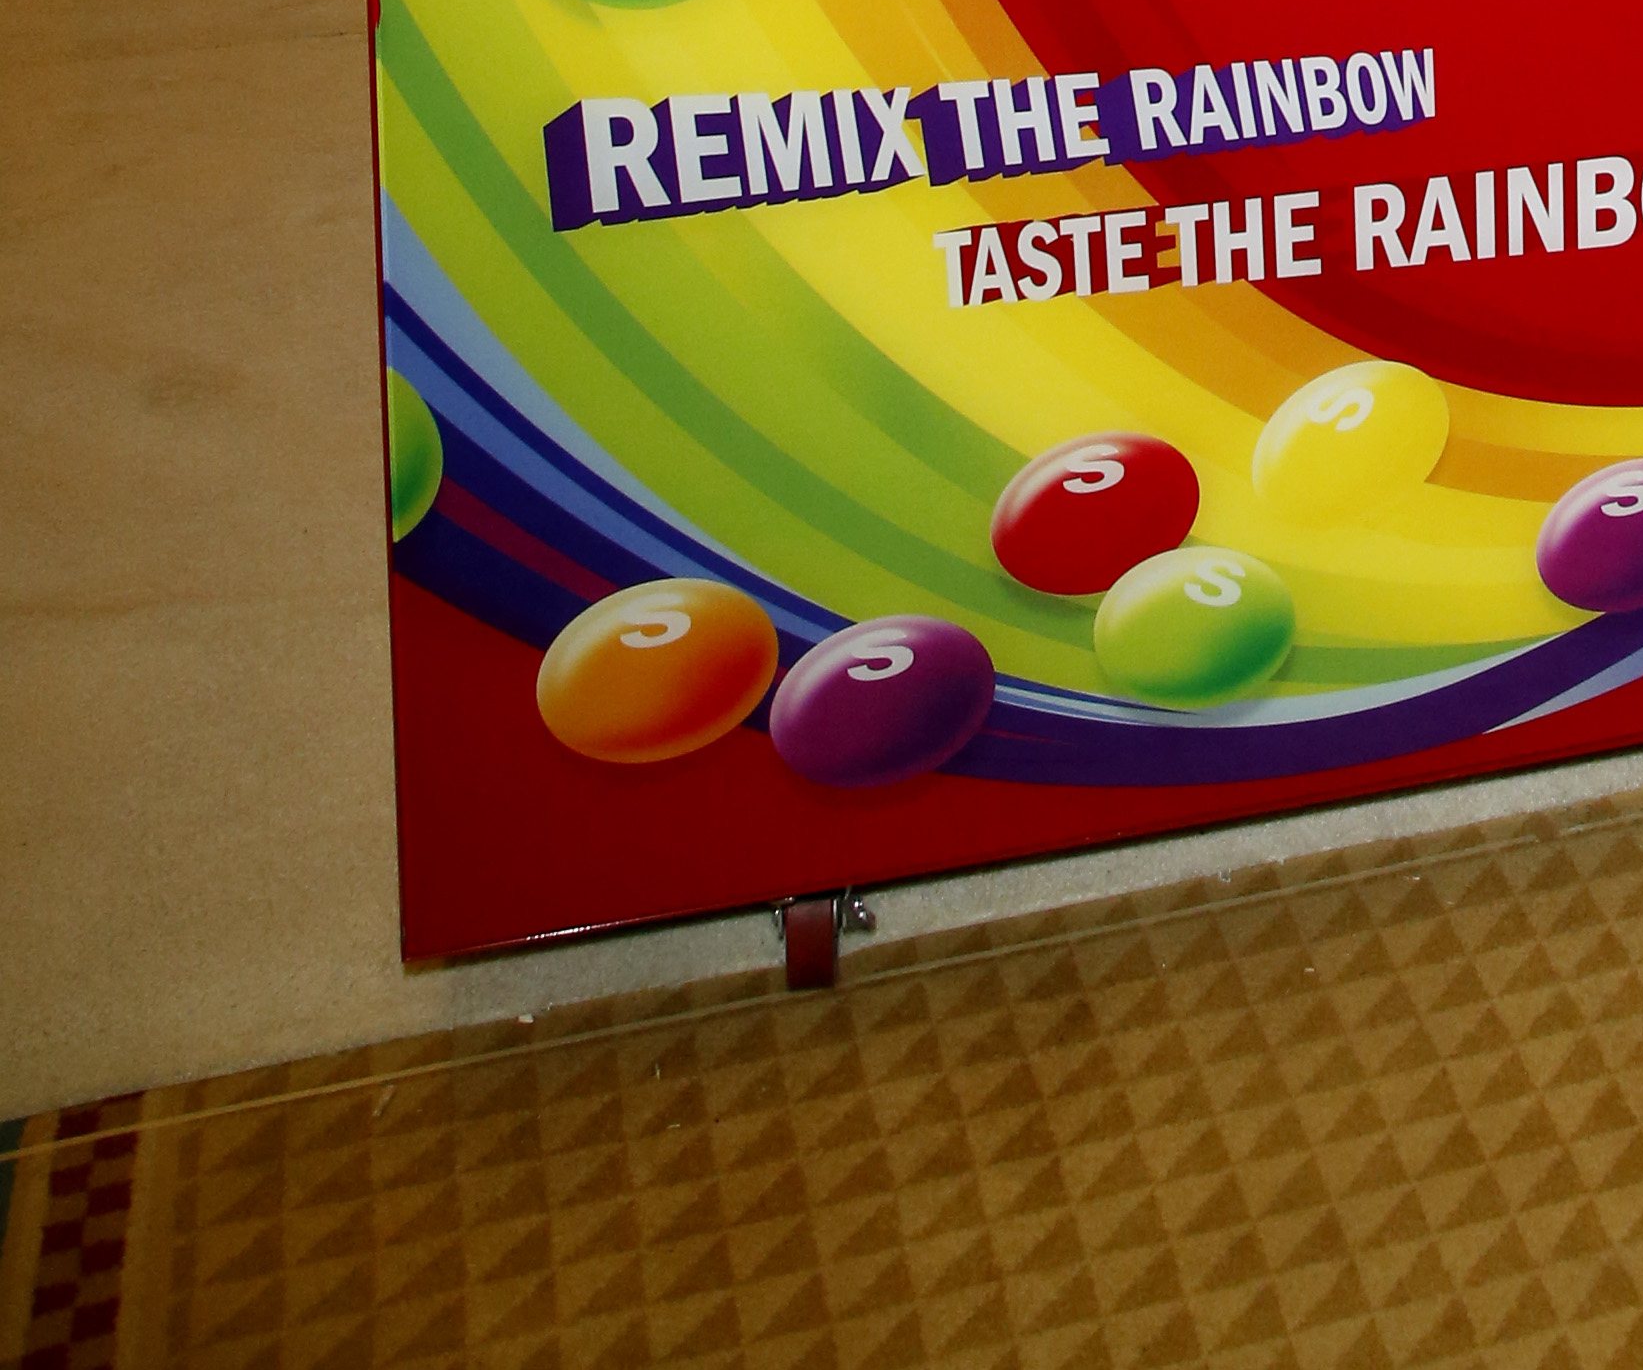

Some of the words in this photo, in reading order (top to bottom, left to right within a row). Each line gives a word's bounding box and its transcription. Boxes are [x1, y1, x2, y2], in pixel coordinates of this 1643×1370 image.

[582, 87, 930, 215] REMIX
[939, 73, 1110, 172] THE
[1133, 48, 1437, 152] RAINBOW
[933, 212, 1152, 308] TASTE
[1164, 190, 1324, 286] THE
